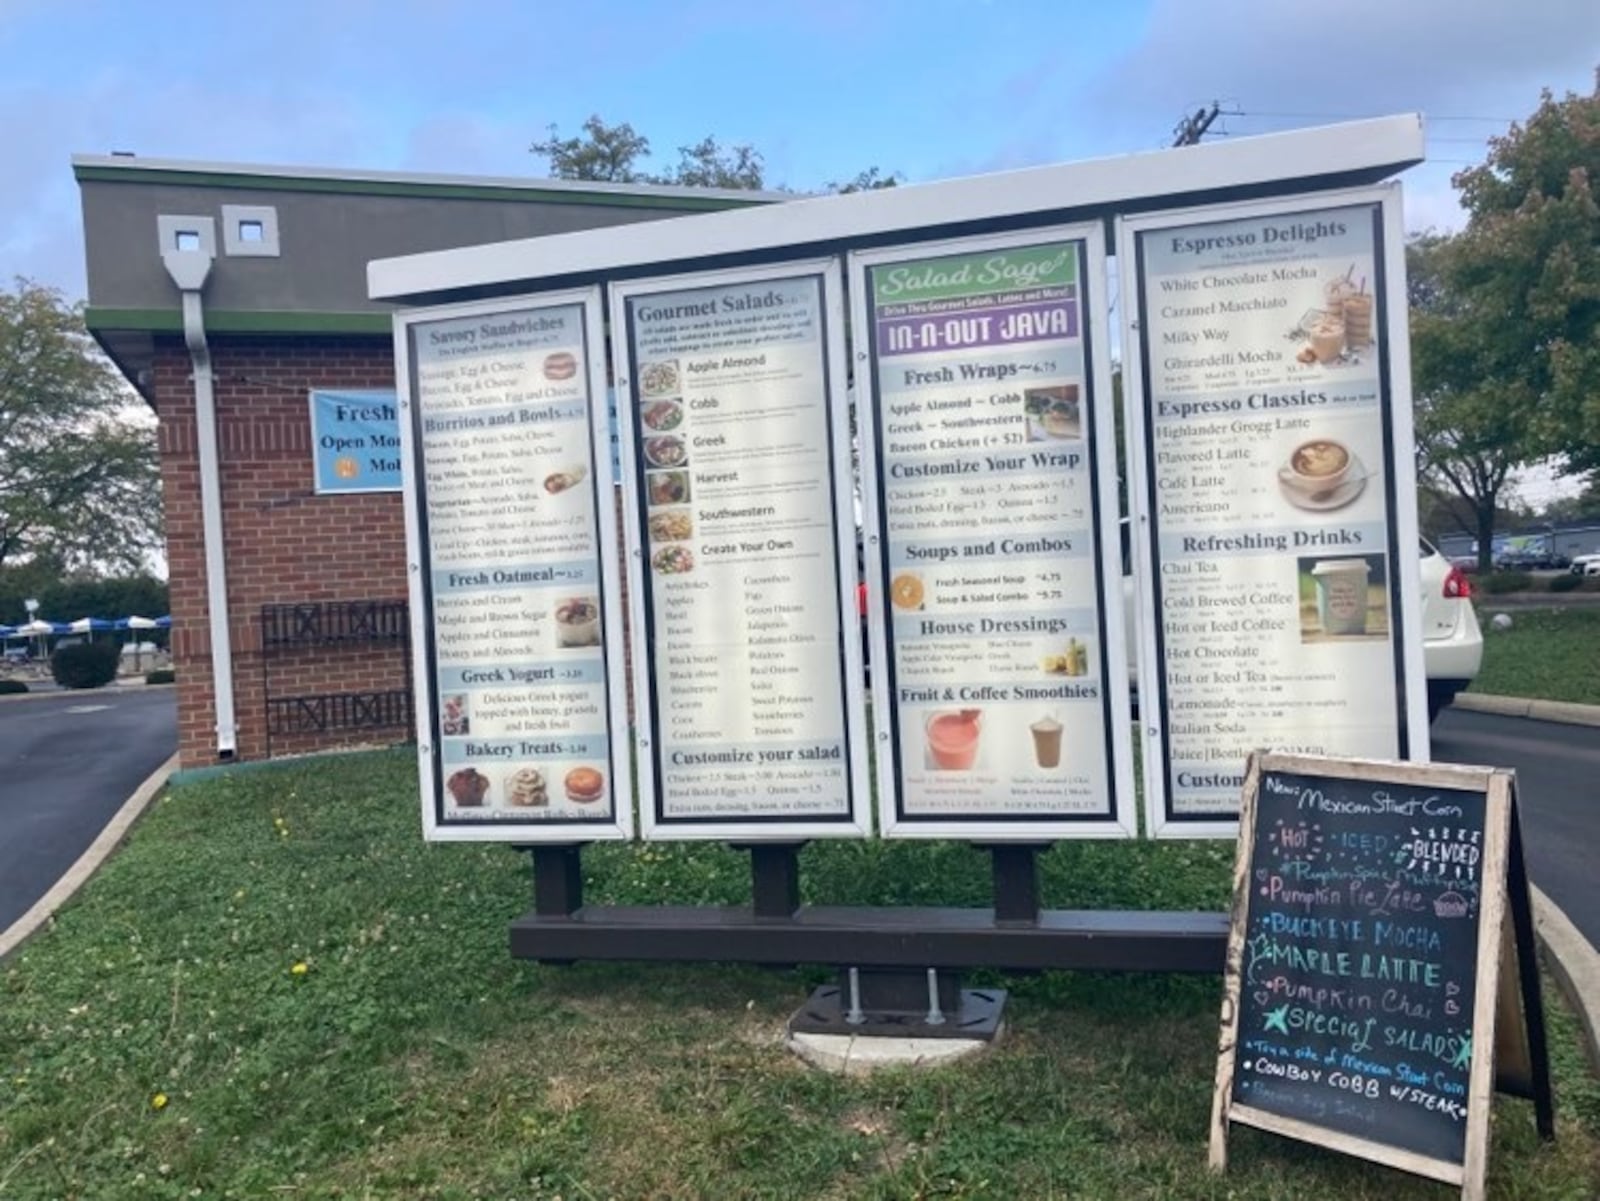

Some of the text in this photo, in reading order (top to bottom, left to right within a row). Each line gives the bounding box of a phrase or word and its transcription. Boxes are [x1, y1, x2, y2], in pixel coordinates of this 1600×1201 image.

[1172, 221, 1347, 255] Espresso Delights
[880, 255, 1059, 295] Salad Sage
[1160, 267, 1317, 292] White Chocolate Mocha
[638, 301, 717, 322] Gourmet
[1161, 298, 1288, 319] Caramel Macchiato
[430, 317, 564, 345] Savory Sandwiches
[889, 308, 1067, 350] IN-N-OUT JAVA
[1163, 329, 1230, 346] Milky Way
[687, 355, 766, 373] Apple Almond
[1164, 350, 1283, 371] Ghirardelli Mocha
[904, 366, 954, 385] Fresh
[336, 405, 394, 421] Fresh
[690, 399, 719, 410] Cobb
[888, 393, 1021, 416] Apple Almond Cobb
[1158, 390, 1328, 419] Espresso Classics
[425, 416, 484, 433] Burritos
[488, 411, 514, 426] and
[888, 415, 1022, 435] Greek Southwestern
[1157, 417, 1310, 439] Highlander Grogg Latte
[321, 435, 364, 452] Open
[693, 436, 725, 447] Greek
[889, 440, 927, 453] Bacon
[930, 435, 980, 451] Chicken
[1158, 447, 1251, 464] Flavored Latte
[891, 452, 1081, 479] Customize Your Wrap
[696, 472, 738, 483] Harvest
[1191, 474, 1225, 488] Latte
[700, 506, 775, 521] Southwestern
[1160, 501, 1230, 515] Americano
[702, 540, 793, 555] Create Your Own
[905, 537, 1072, 561] Soups and Combos
[1183, 528, 1363, 554] Refreshing Drinks
[1162, 561, 1218, 575] Chai Tea
[449, 573, 488, 587] Fresh
[1164, 591, 1295, 609] Cold Brewed Coffee
[921, 617, 1067, 635] House Dressings
[1166, 618, 1286, 634] Hot or Iced Coffee
[1167, 645, 1259, 659] Hot Chocolate
[462, 667, 554, 683] Greek Yogurt
[1169, 673, 1192, 684] Hot
[1195, 674, 1210, 684] or
[1213, 671, 1241, 683] Iced
[1244, 671, 1266, 682] Tea
[901, 684, 1098, 701] Fruit & Coffee Smoothies
[1170, 721, 1246, 735] Italian Soda
[466, 744, 513, 757] Bakery
[672, 746, 840, 765] Customize your salad
[1298, 789, 1371, 814] Mexican
[1372, 791, 1422, 816] Street
[1423, 797, 1463, 817] Corn
[1342, 832, 1388, 850] ICED
[1413, 840, 1480, 864] BLENDED
[1270, 876, 1341, 913] Pumpkin
[1271, 912, 1441, 953] BUCKEYE MOCHA
[1272, 943, 1442, 987] MAPLE LATTE
[1272, 976, 1432, 1019] Pumpkin Chai
[1384, 1027, 1459, 1063] SALADS
[1341, 1054, 1392, 1076] Mexican
